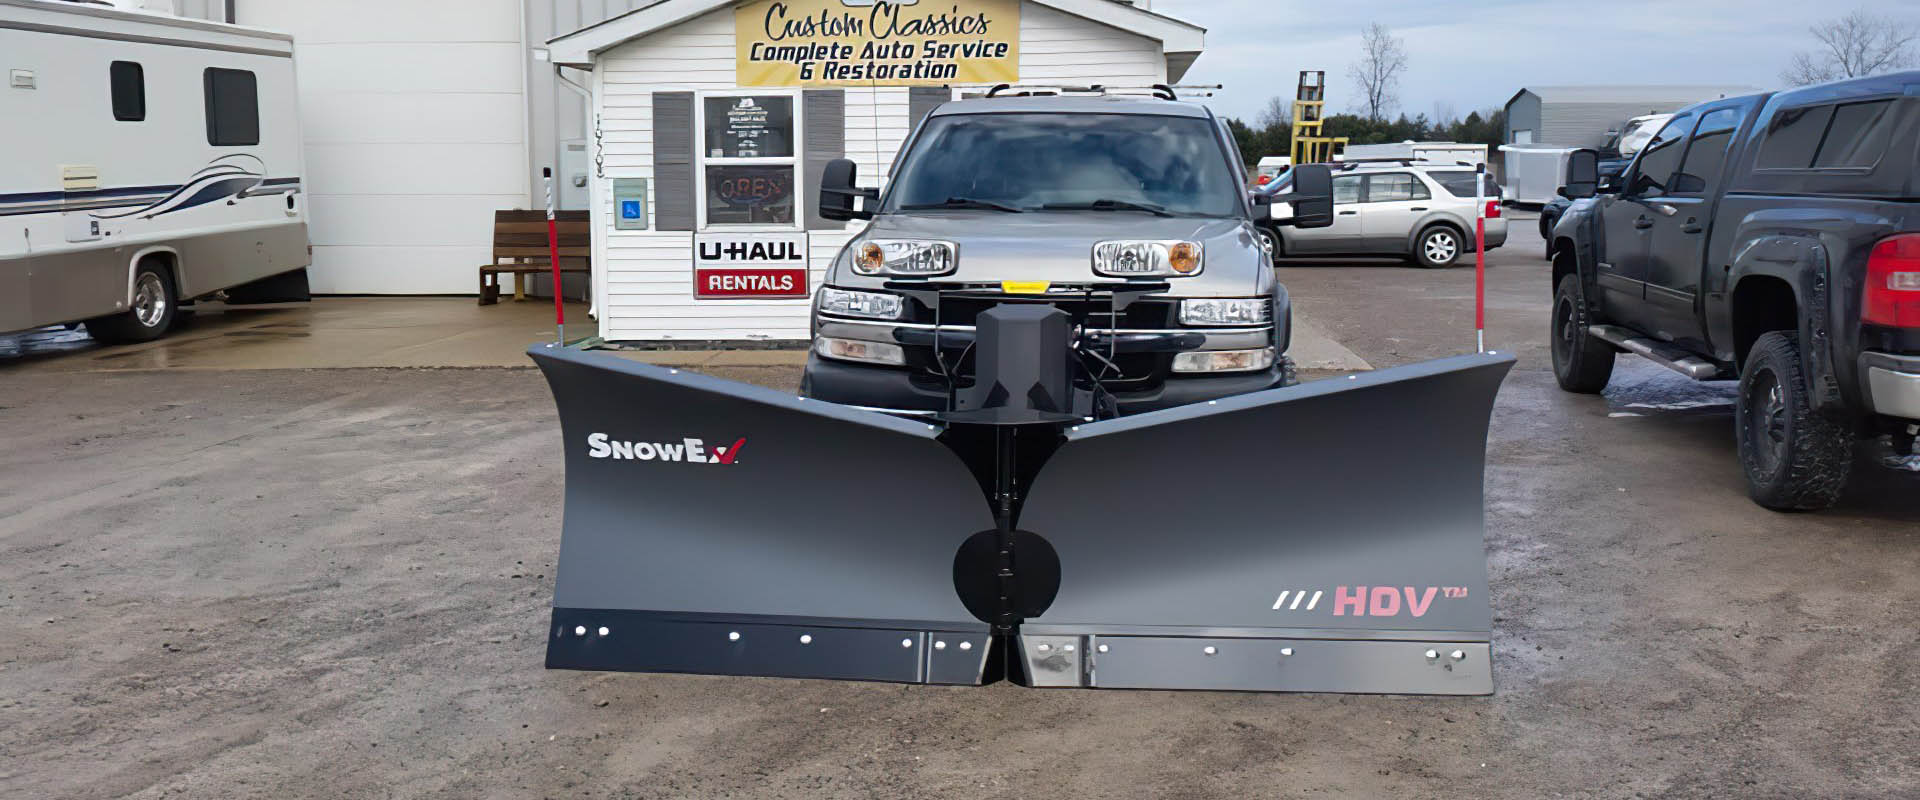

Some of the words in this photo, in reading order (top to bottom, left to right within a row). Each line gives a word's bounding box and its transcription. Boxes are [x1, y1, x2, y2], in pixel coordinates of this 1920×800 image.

[764, 2, 863, 41] Custom
[869, 1, 992, 39] Classics
[750, 41, 854, 64] Complete
[860, 40, 915, 60] Auto
[922, 39, 1009, 59] Service
[823, 60, 958, 80] Restoration
[721, 176, 784, 199] OPEN
[699, 242, 803, 261] U-HAUL
[708, 274, 794, 291] RENTALS
